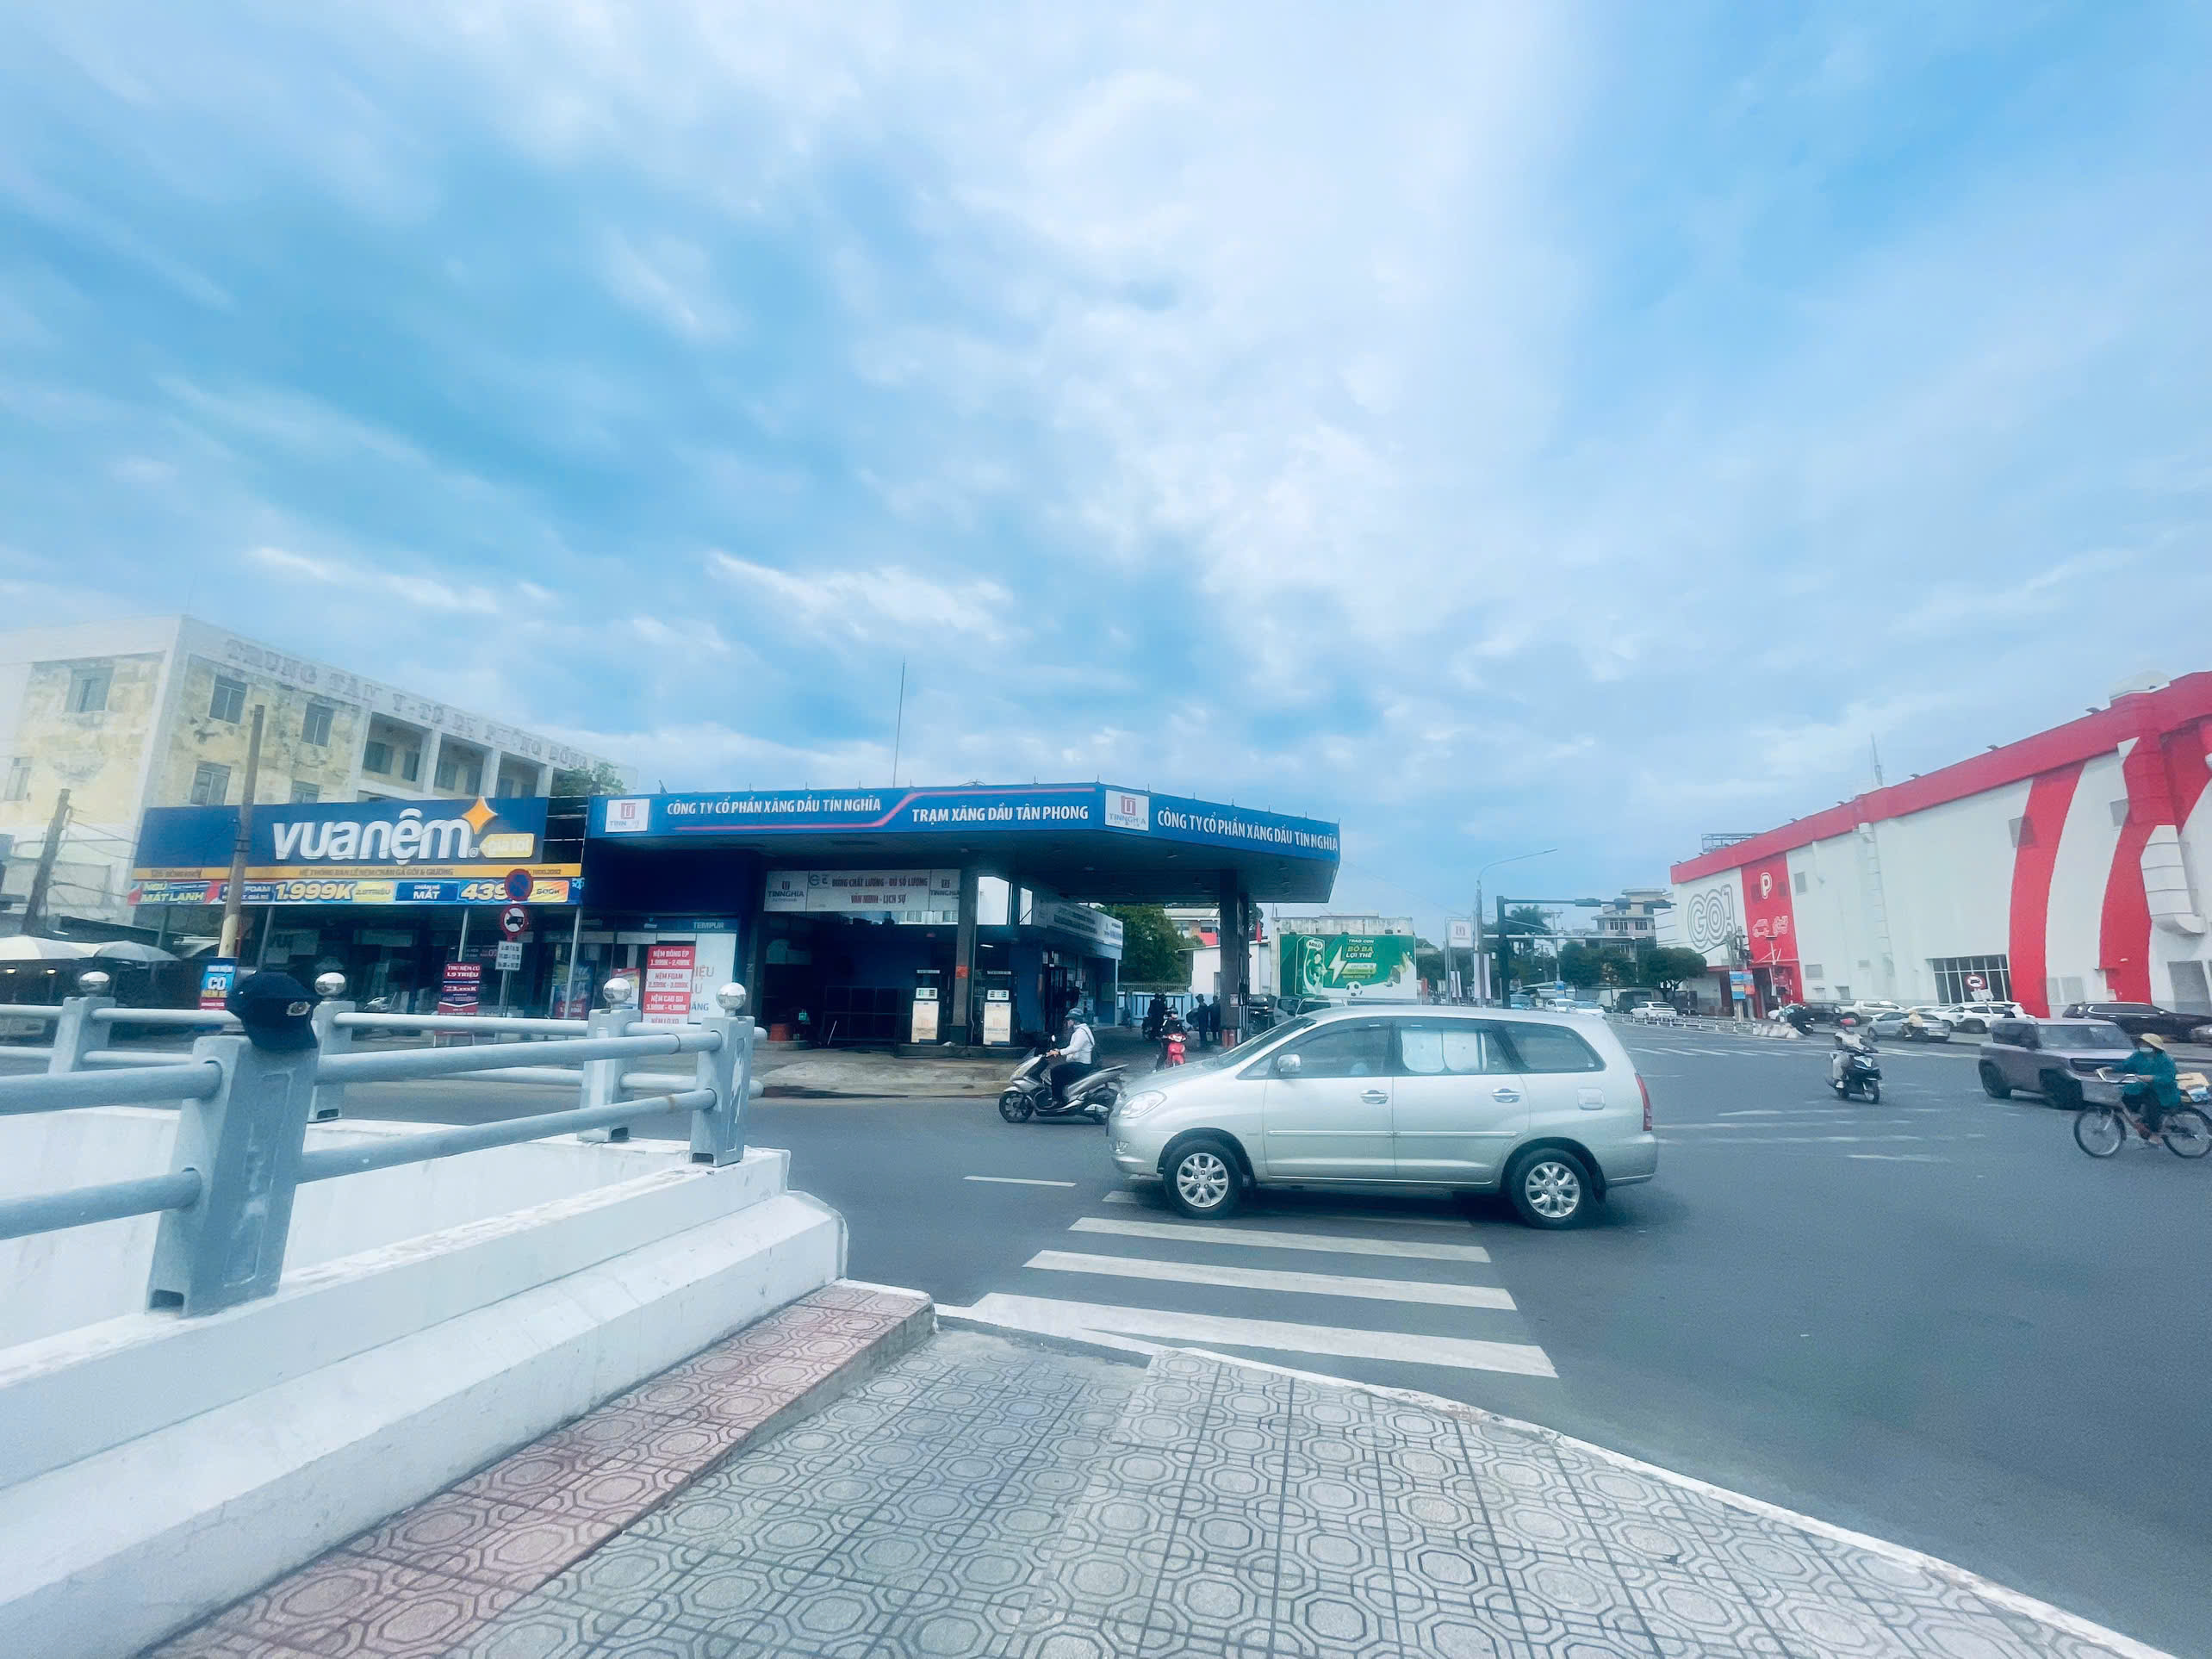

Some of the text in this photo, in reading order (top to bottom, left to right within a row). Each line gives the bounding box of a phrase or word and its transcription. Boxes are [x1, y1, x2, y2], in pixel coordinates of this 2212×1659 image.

[668, 794, 881, 815] CÔNG TY CỔ PHẦN XĂNG DẦU TÍN NGHĨA
[912, 801, 1089, 825] TRẠM XĂNG DẦU TÂN PHONG
[1157, 806, 1339, 851] CÔNG TY CỔ PHẦN XĂNG DẦU TÍN NGHĨA
[275, 882, 357, 901] 1.999K
[413, 889, 440, 899] MÁT
[460, 883, 507, 900] 439
[1761, 872, 1773, 899] P
